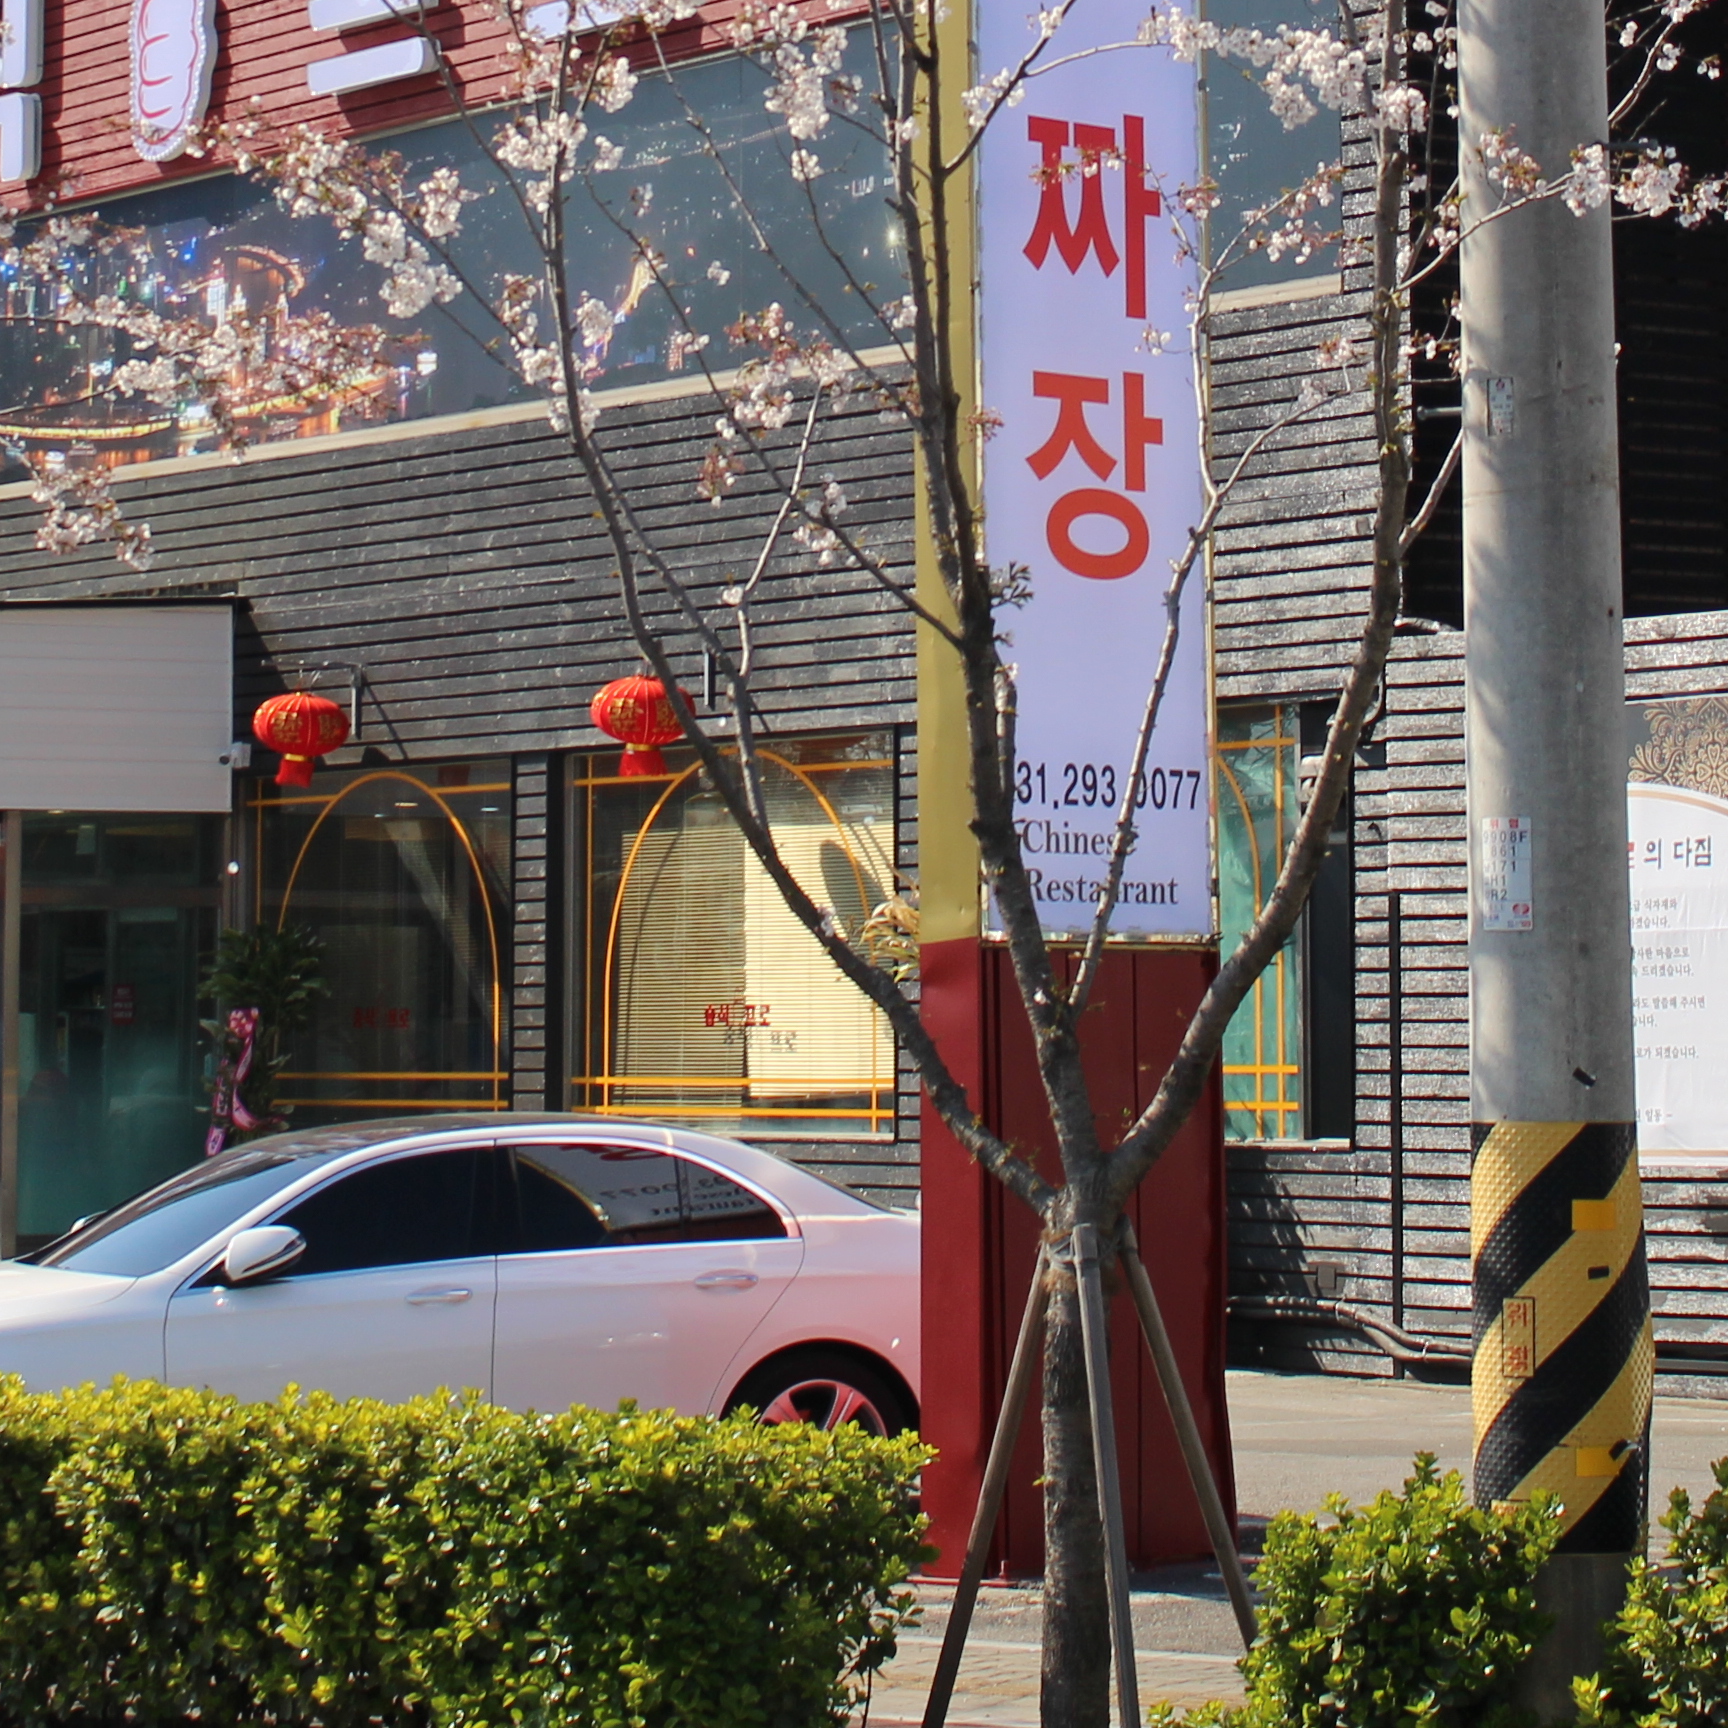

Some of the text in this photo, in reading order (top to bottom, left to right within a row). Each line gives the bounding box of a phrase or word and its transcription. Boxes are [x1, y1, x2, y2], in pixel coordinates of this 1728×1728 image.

[1022, 114, 1164, 581] 짜장
[1016, 760, 1201, 810] 31.2930077
[1022, 818, 1118, 856] Chines
[1673, 835, 1712, 868] 다짐
[1024, 867, 1179, 905] Restarant
[1631, 915, 1671, 929] 겠습니다.
